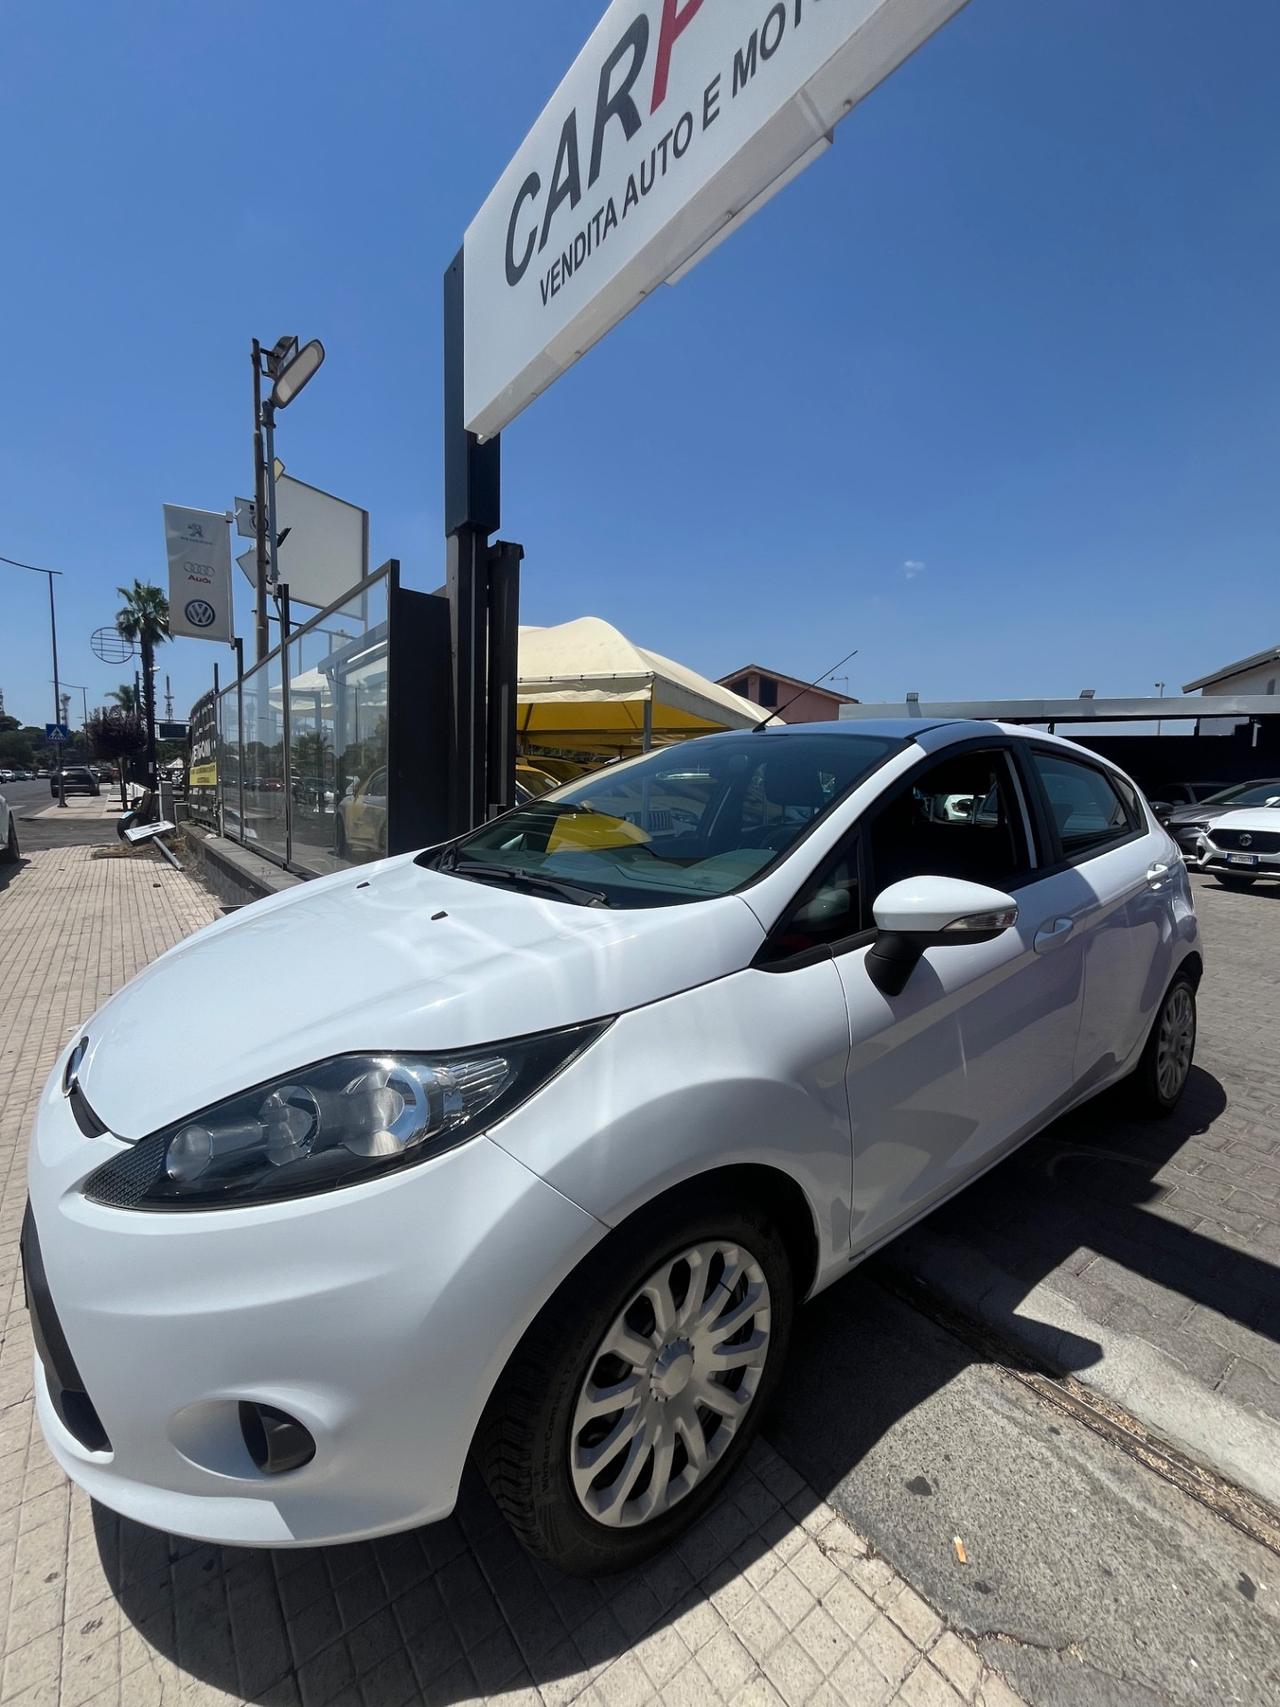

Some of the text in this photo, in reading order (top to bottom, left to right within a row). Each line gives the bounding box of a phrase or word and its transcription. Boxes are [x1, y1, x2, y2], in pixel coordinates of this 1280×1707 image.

[539, 0, 821, 306] VENDITA AUTO E MO
[187, 574, 212, 585] Audi
